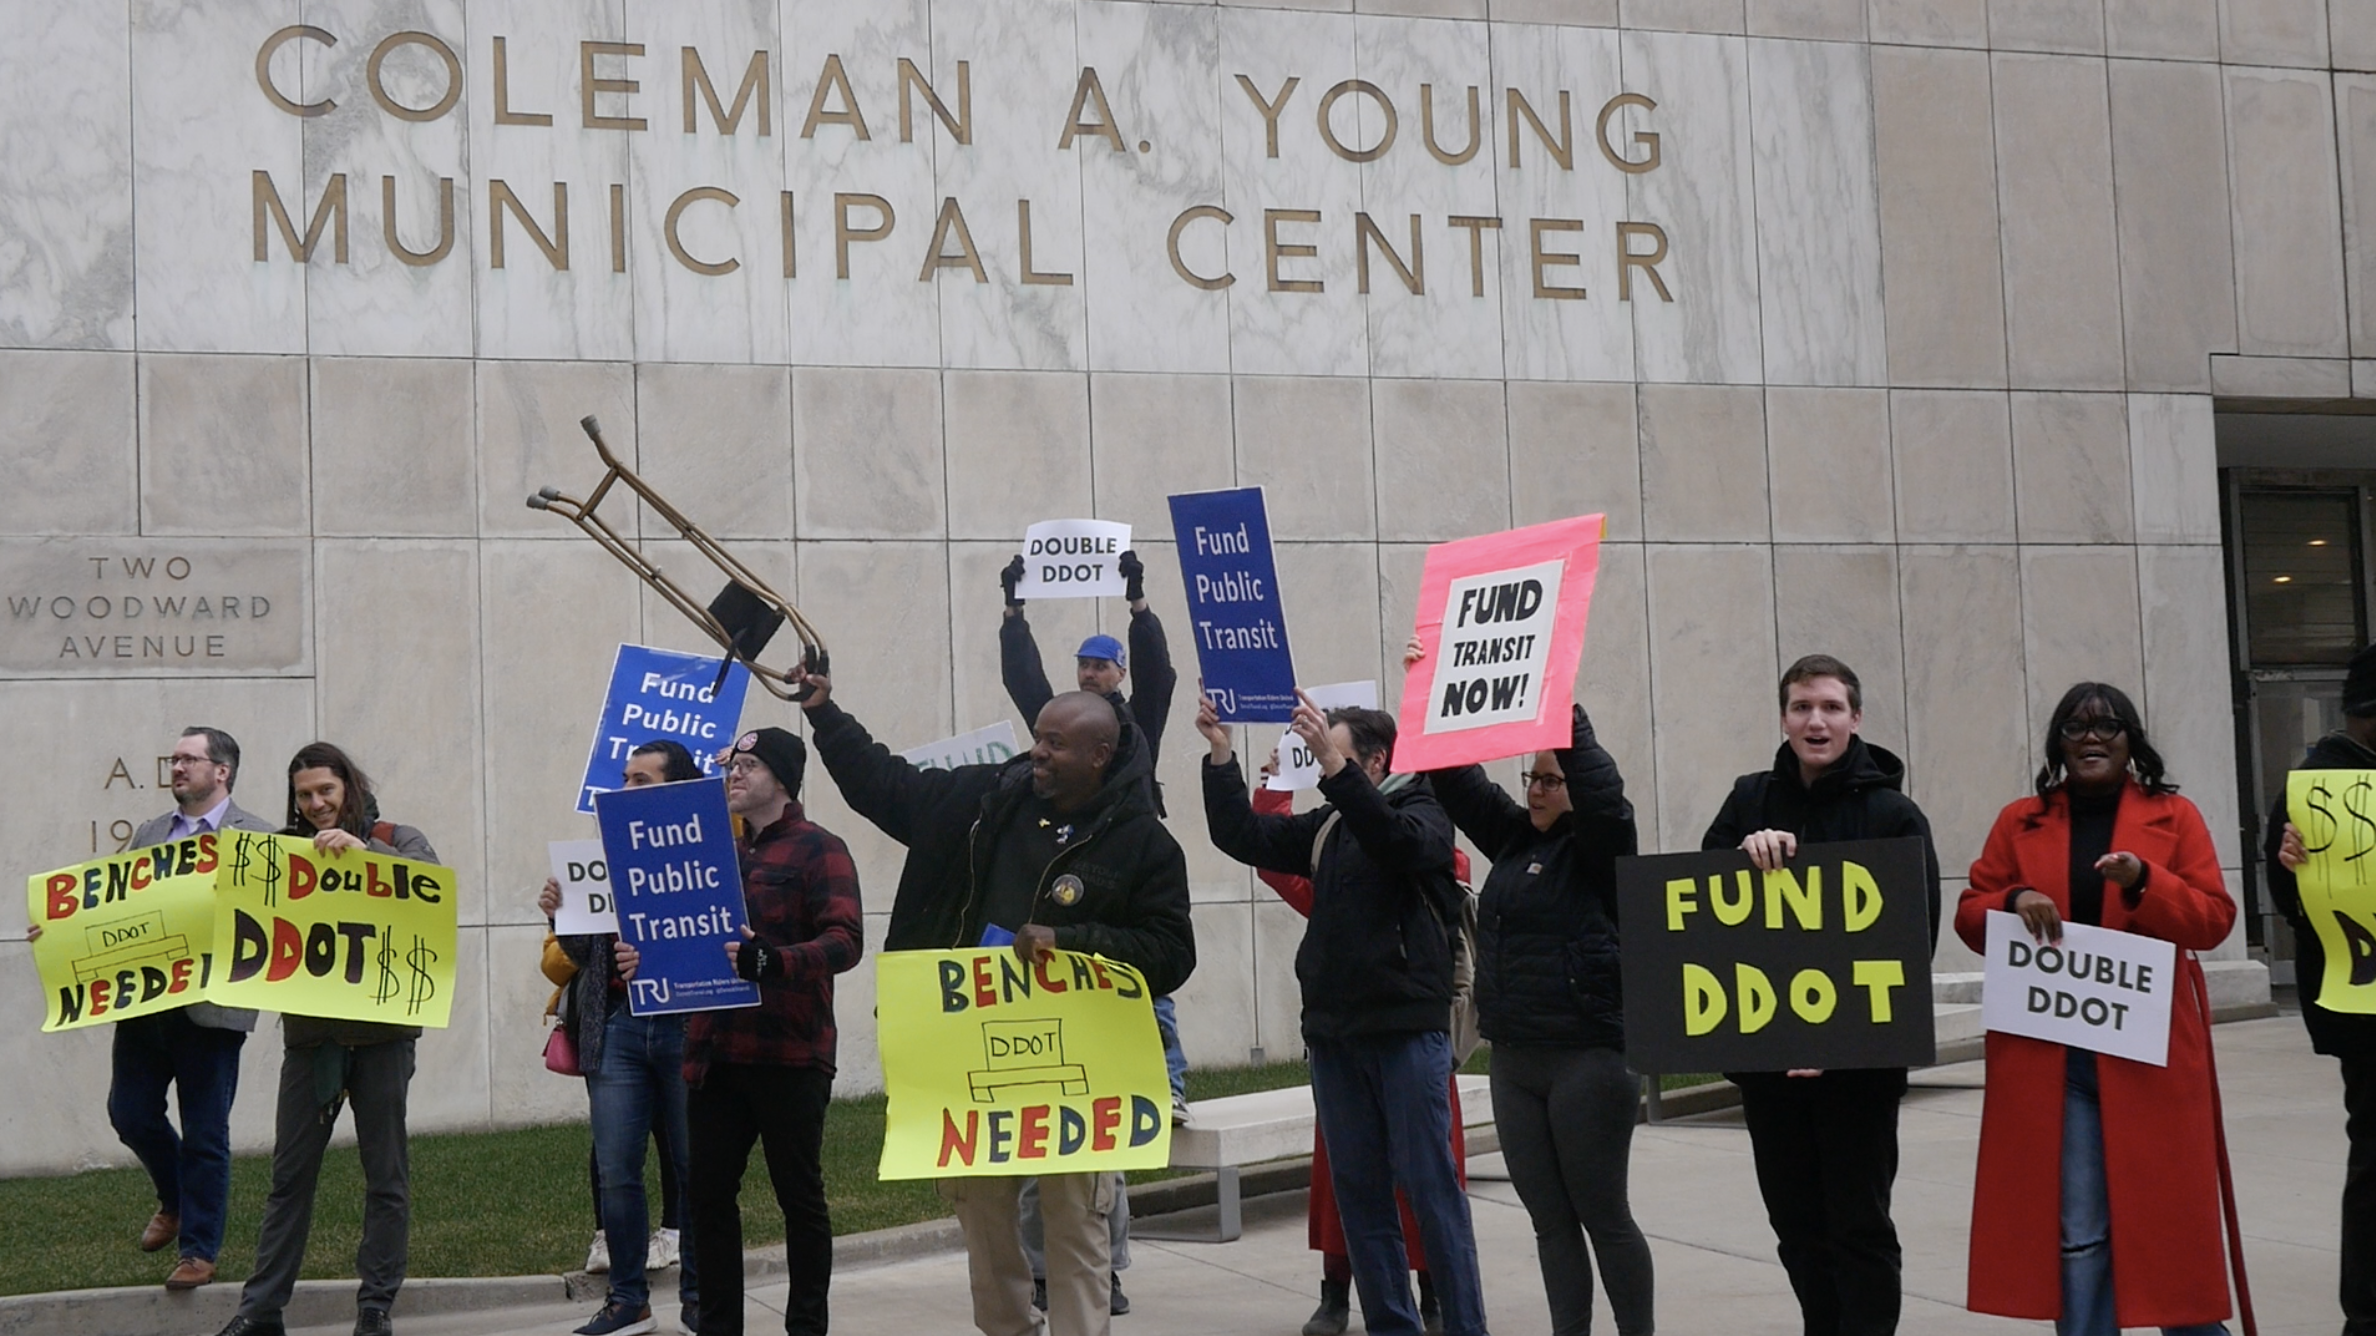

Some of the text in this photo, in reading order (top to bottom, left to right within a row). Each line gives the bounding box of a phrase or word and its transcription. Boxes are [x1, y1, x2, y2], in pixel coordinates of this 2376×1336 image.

[254, 24, 1663, 175] COLEMAN A. YOUNG
[251, 169, 1675, 304] MUNICIPAL CENTER
[1029, 536, 1118, 557] DOUBLE
[1195, 521, 1250, 556] Fund
[88, 556, 192, 581] TWO
[1041, 563, 1104, 584] DDOT
[1196, 570, 1265, 604] Public
[1457, 578, 1543, 628] FUND
[7, 595, 271, 620] WOODWARD
[59, 635, 226, 659] AVENUE
[1199, 618, 1279, 651] Transit
[1453, 634, 1535, 668] TRANSIT
[640, 671, 717, 704] Fund
[1441, 672, 1529, 718] NOW!
[622, 703, 717, 739] Public
[628, 813, 703, 850] Fund
[46, 834, 218, 920] BENCHES
[628, 860, 719, 896] Public
[1665, 860, 1884, 932] FUND
[102, 921, 149, 948] DDOT
[629, 905, 734, 942] Transit
[938, 950, 1143, 1014] BENCHES
[2007, 940, 2153, 994] DOUBLE
[1682, 960, 1905, 1036] DDOT
[2027, 985, 2130, 1032] DDOT
[990, 1031, 1057, 1058] DDOT
[936, 1095, 1162, 1168] NEEDED
